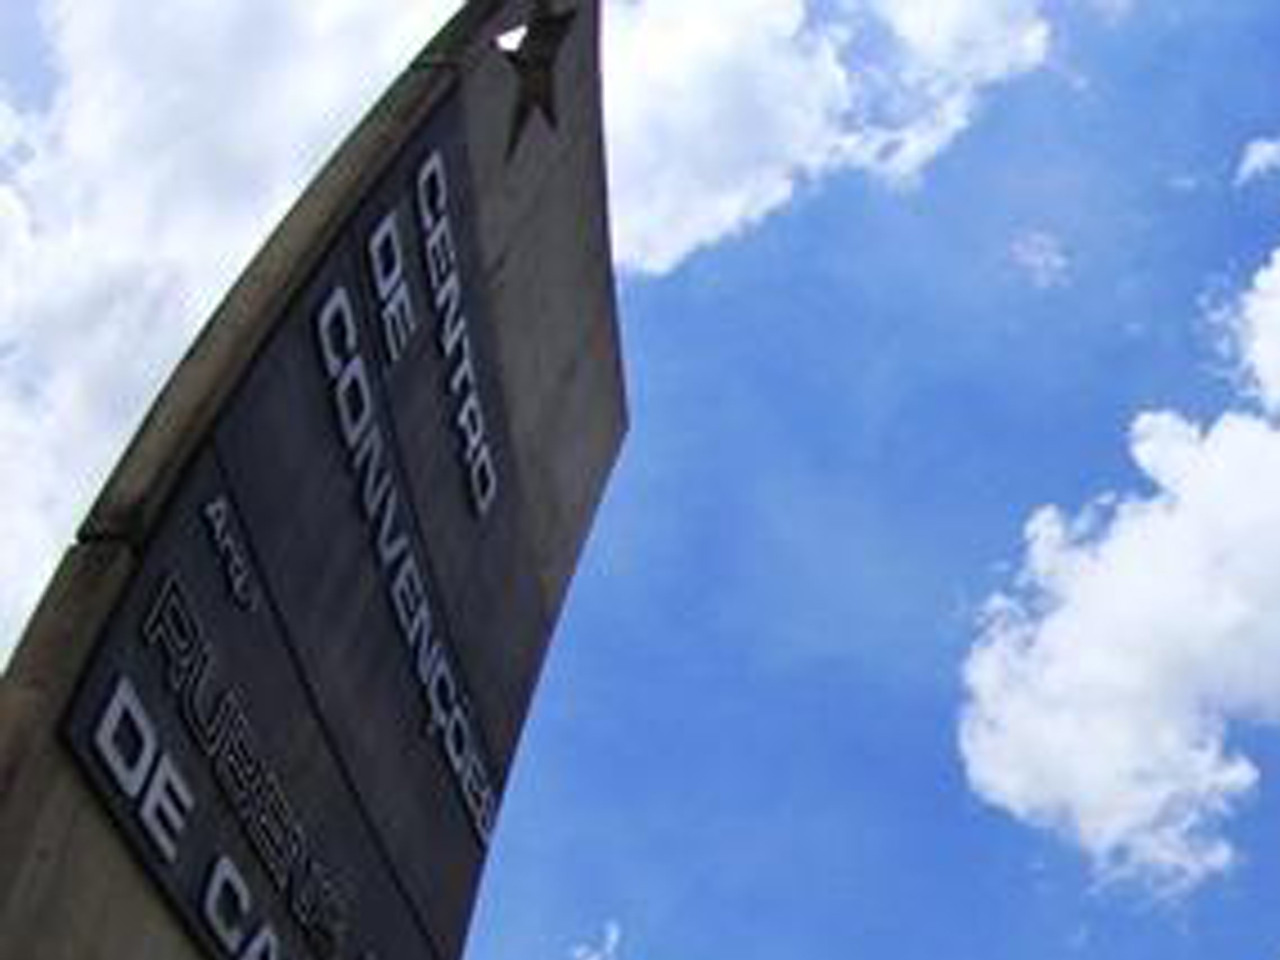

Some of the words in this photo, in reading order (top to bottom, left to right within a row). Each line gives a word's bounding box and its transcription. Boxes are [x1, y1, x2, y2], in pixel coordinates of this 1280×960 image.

[369, 210, 417, 362] DE
[417, 150, 497, 516] CENTRO
[95, 675, 196, 863] DE
